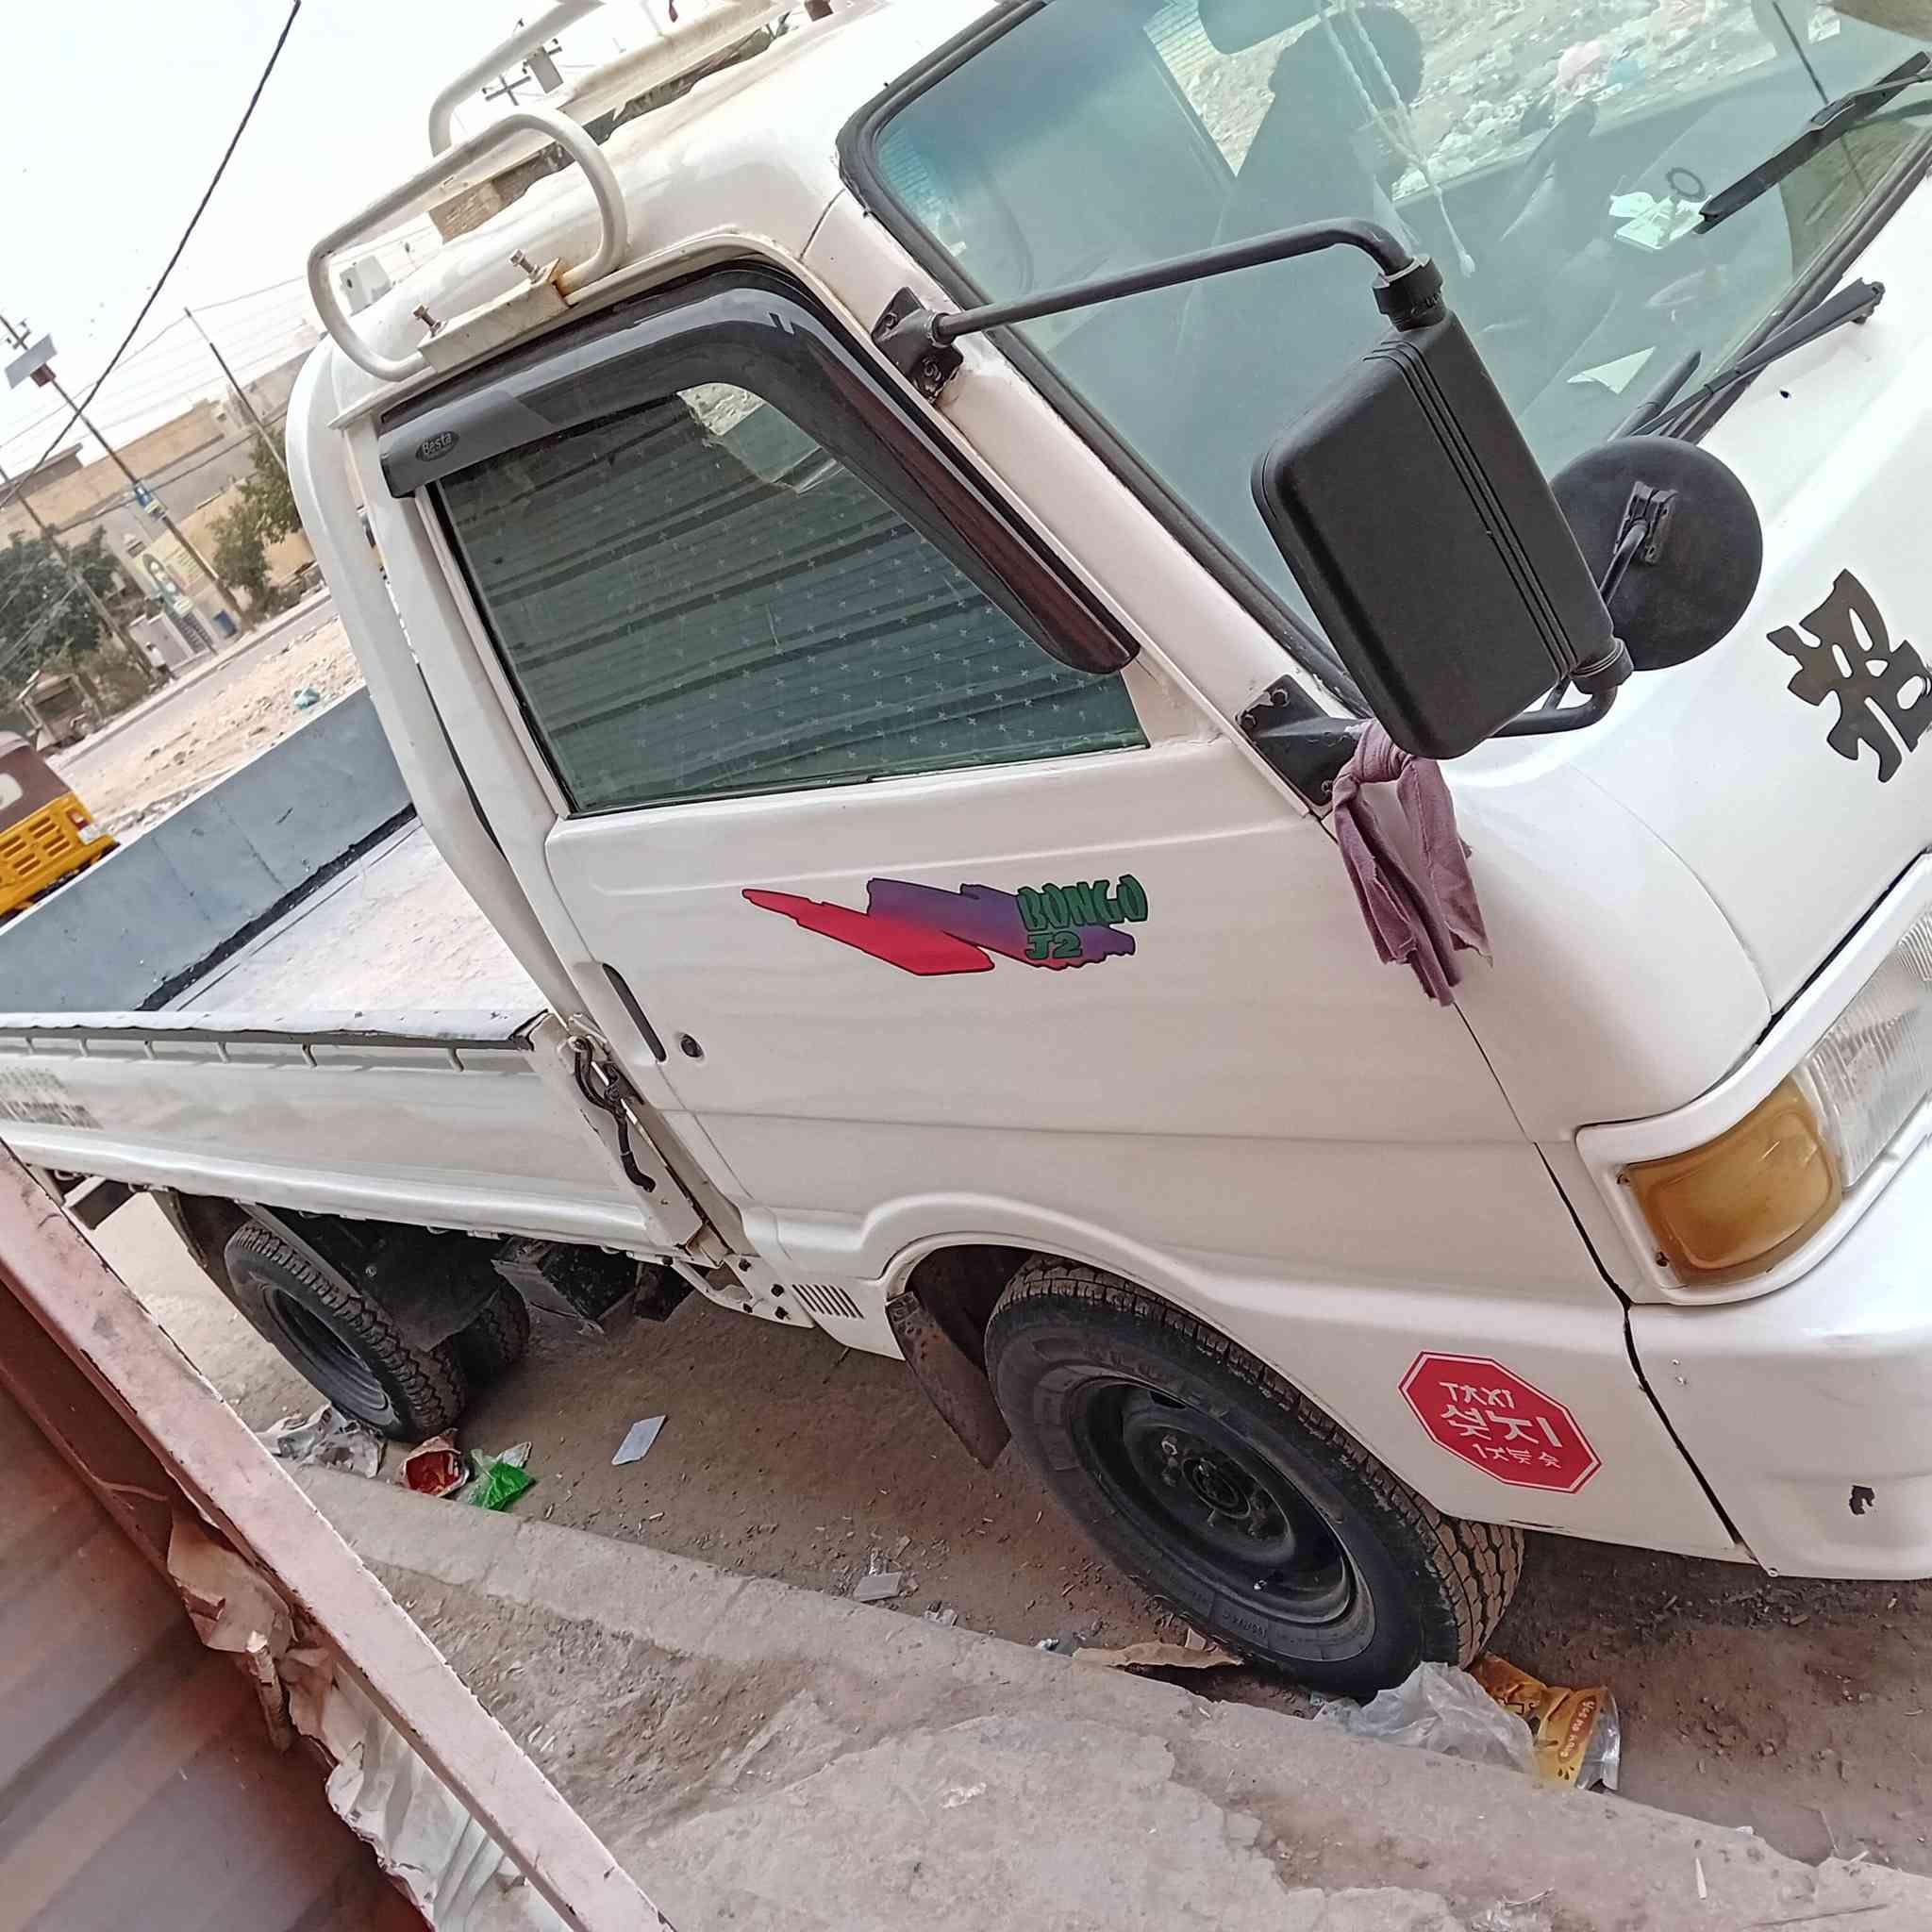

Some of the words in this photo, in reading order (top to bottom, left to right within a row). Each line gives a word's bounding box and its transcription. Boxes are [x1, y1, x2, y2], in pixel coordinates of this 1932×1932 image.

[422, 433, 453, 455] Besta
[1016, 874, 1148, 931] BONGO
[1024, 930, 1083, 959] J2
[1440, 1381, 1515, 1409] TAXI
